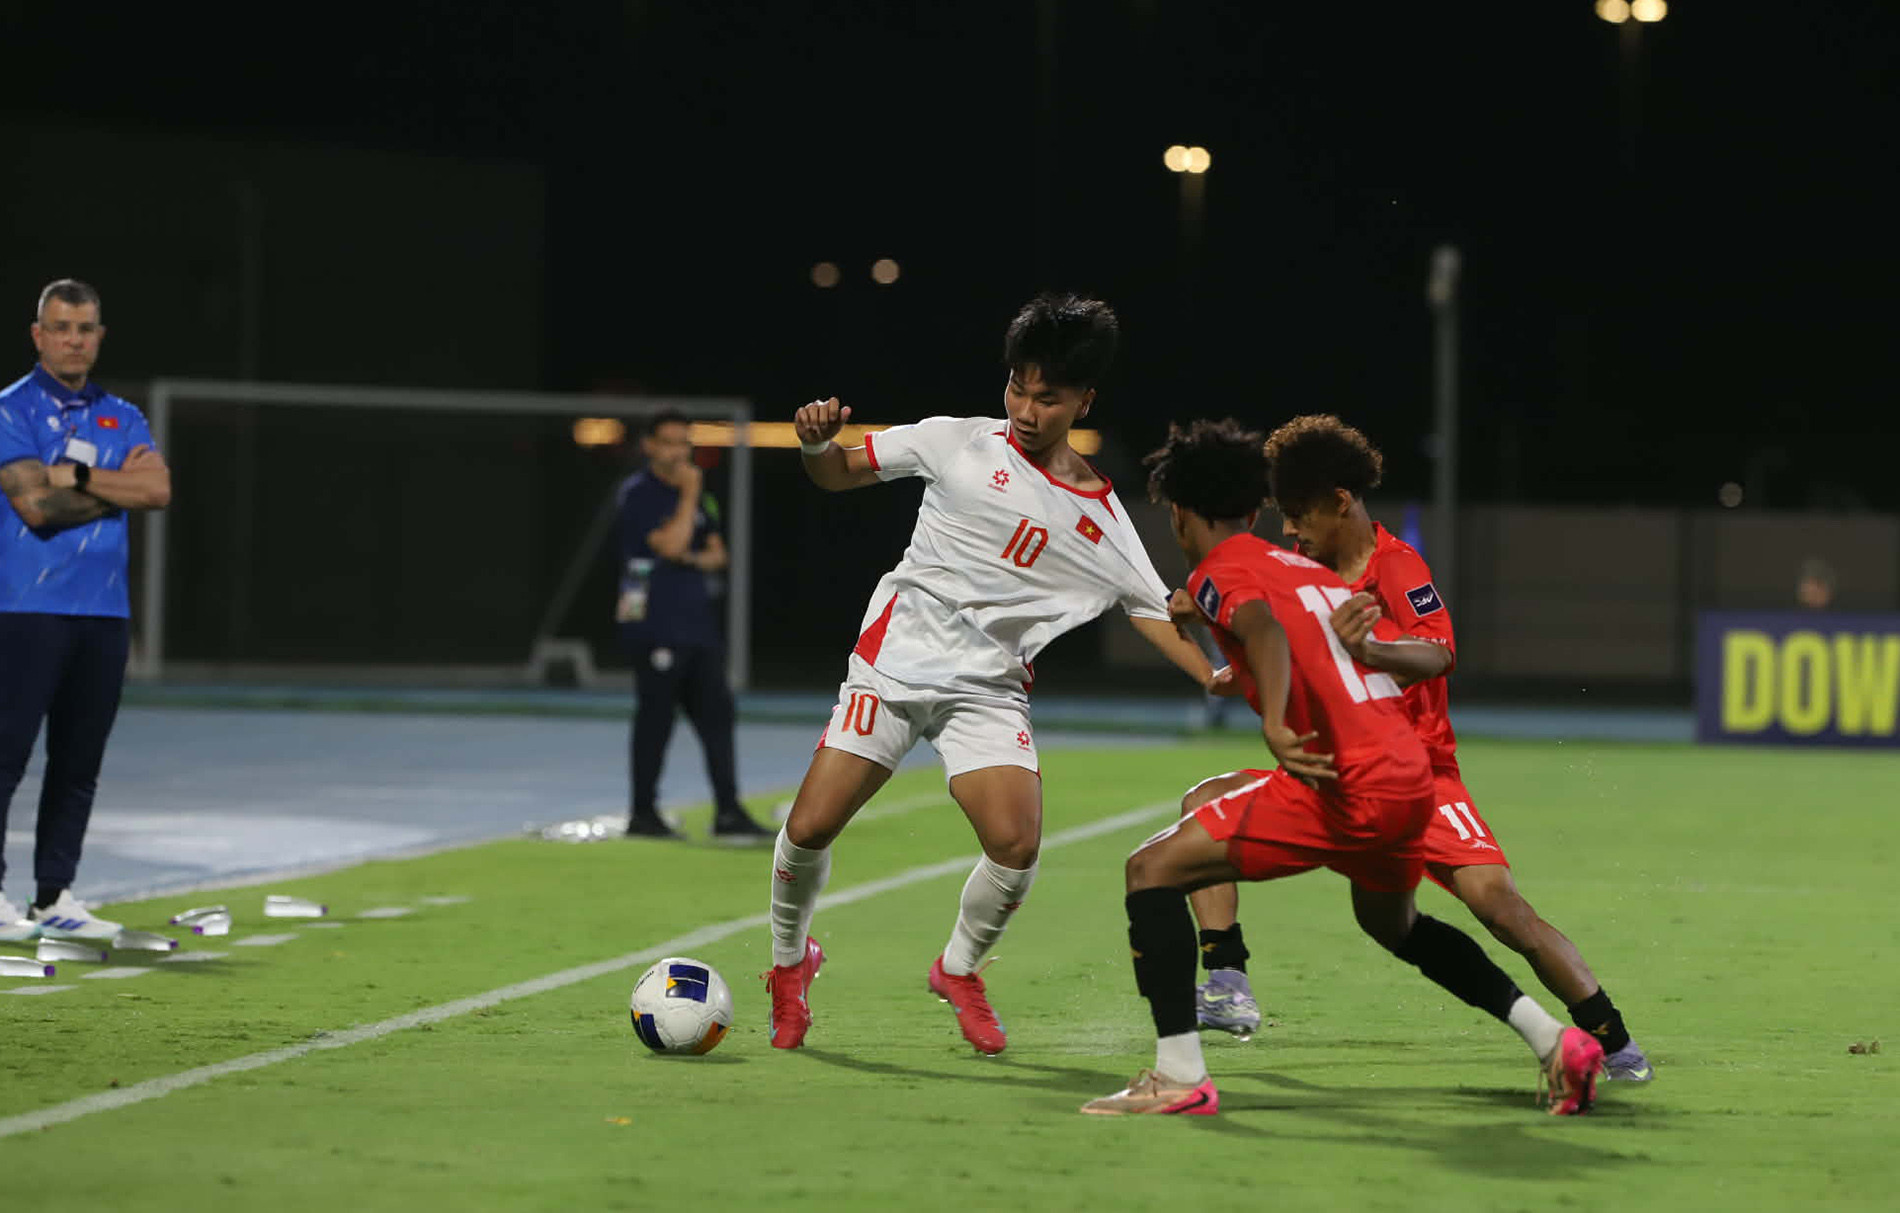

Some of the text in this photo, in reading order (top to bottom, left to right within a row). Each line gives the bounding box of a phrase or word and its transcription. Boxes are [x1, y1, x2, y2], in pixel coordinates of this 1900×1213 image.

[1001, 518, 1049, 568] 10
[1723, 631, 1900, 736] DOW
[841, 692, 879, 736] 10
[1439, 801, 1487, 841] 11
